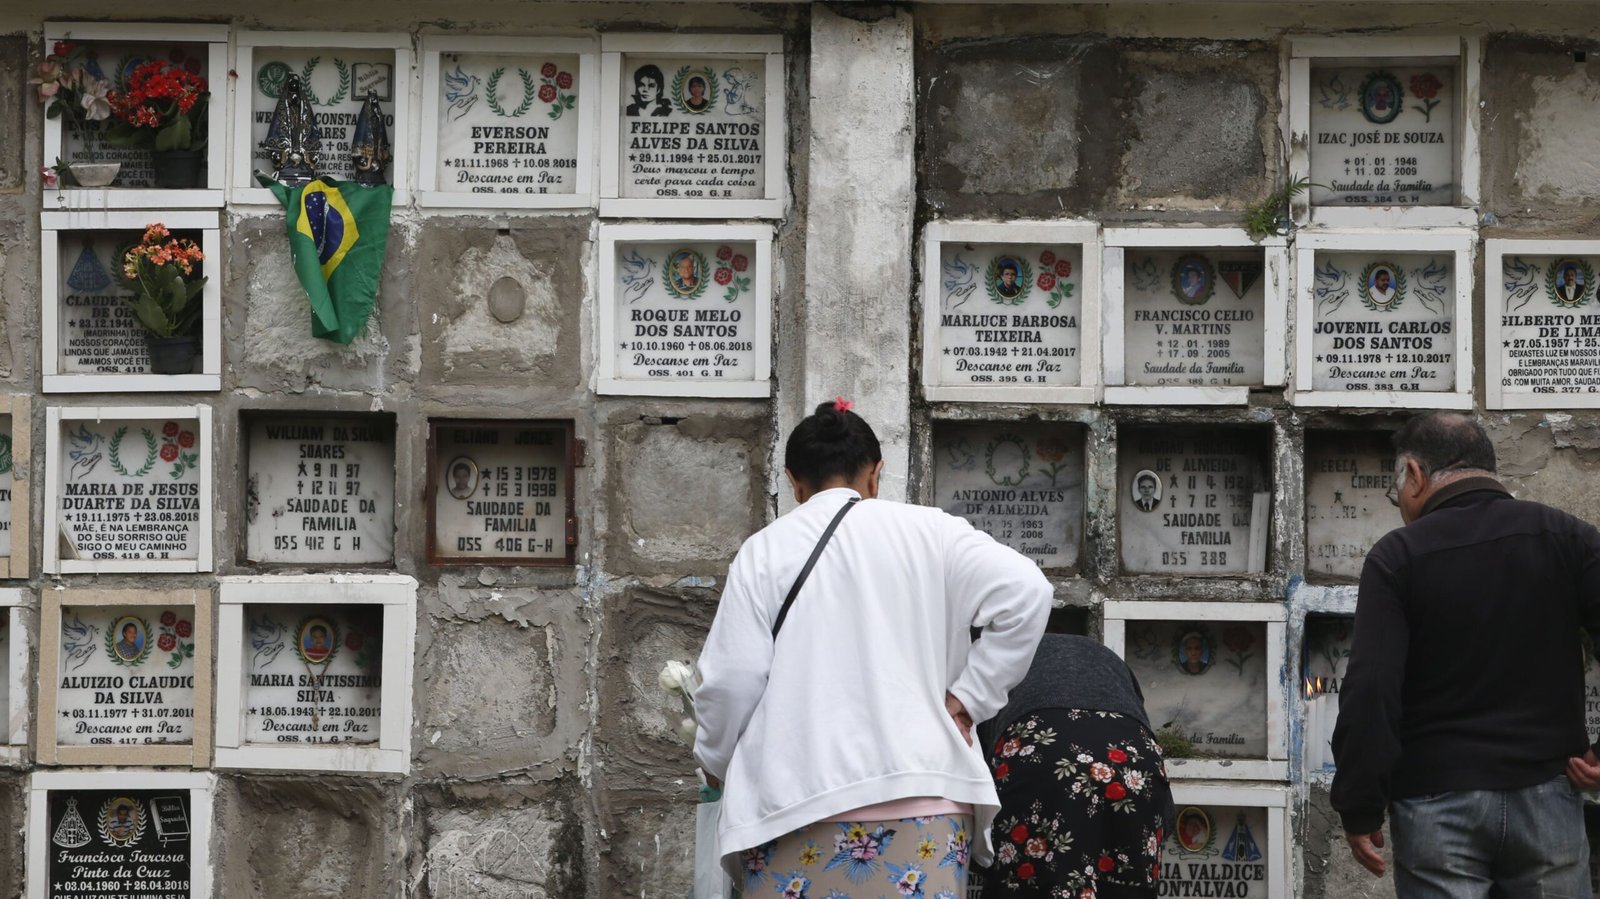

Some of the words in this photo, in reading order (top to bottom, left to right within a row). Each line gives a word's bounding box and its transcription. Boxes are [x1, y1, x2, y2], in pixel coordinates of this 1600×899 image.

[471, 126, 550, 139] EVERSON
[631, 122, 690, 134] FELIPE
[696, 122, 760, 136] SANTOS
[630, 137, 681, 149] ALVES
[687, 138, 708, 150] DA
[714, 138, 759, 151] SILVA
[1318, 133, 1347, 144] IZAC
[1350, 130, 1381, 147] JOSÉ
[1384, 133, 1400, 144] DE
[1404, 133, 1445, 144] SOUZA
[473, 142, 547, 154] PEREIRA
[454, 159, 509, 168] 21.11.1968
[639, 154, 694, 163] 29.11.1994
[708, 154, 762, 164] 25.01.2017
[632, 164, 661, 174] Deus
[665, 166, 708, 174] marcou
[721, 166, 755, 177] tempo
[457, 170, 513, 184] Descanse
[517, 175, 534, 184] em
[538, 171, 563, 184] Paz
[634, 177, 661, 185] certo
[664, 178, 693, 188] para
[696, 177, 724, 186] cada
[727, 178, 756, 187] coisa
[1331, 180, 1374, 193] Saudade
[1377, 180, 1390, 191] da
[1393, 180, 1433, 192] Familia
[92, 308, 110, 318] DE
[631, 309, 689, 322] ROQUE
[695, 309, 742, 322] MELO
[1134, 310, 1211, 322] FRANCISCO
[1214, 310, 1255, 322] CELIO
[79, 320, 134, 328] 23.12.1944
[941, 315, 1008, 327] MARLUCE
[1012, 316, 1077, 328] BARBOSA
[635, 324, 668, 337] DOS
[673, 325, 738, 338] SANTOS
[1172, 324, 1232, 335] MARTINS
[1314, 322, 1383, 334] JOVENIL
[1388, 322, 1451, 334] CARLOS
[1539, 327, 1560, 338] DE
[975, 330, 1042, 343] TEIXEIRA
[69, 339, 101, 347] NOSSOS
[102, 337, 145, 349] CORAÇÕES
[631, 342, 685, 351] 10.10.1960
[698, 342, 753, 351] 08.06.2018
[1333, 337, 1365, 349] DOS
[1370, 337, 1433, 349] SANTOS
[1513, 339, 1570, 348] 27.05.1957
[64, 348, 92, 356] LINDAS
[94, 348, 109, 356] QUE
[111, 348, 139, 356] JAMAIS
[953, 347, 1008, 357] 07.03.1942
[1022, 347, 1076, 357] 21.04.2017
[1509, 350, 1544, 358] DEIXASTES
[1545, 350, 1558, 358] LUZ
[1559, 350, 1569, 358] EM
[1570, 350, 1597, 358] NOSSOS
[113, 356, 134, 365] VOCÊ
[633, 353, 689, 366] Descanse
[693, 358, 710, 366] em
[713, 354, 738, 367] Paz
[1326, 354, 1382, 363] 09.11.1978
[1396, 354, 1451, 363] 12.10.2017
[1525, 359, 1569, 368] LEMBRANÇAS
[956, 359, 1012, 372] Descanse
[1016, 364, 1033, 372] em
[1036, 360, 1062, 372] Paz
[1144, 362, 1187, 374] Saudade
[1190, 362, 1203, 374] da
[1206, 362, 1245, 374] Familia
[1329, 366, 1386, 379] Descanse
[1390, 370, 1407, 379] em
[1411, 366, 1437, 379] Paz
[1531, 378, 1550, 386] MUITA
[300, 444, 345, 459] SOARES
[1183, 458, 1238, 473] ALMEIDA
[65, 483, 117, 496] MARIA
[122, 483, 144, 496] DE
[149, 483, 198, 496] JESUS
[953, 490, 1016, 502] ANTONIO
[1020, 491, 1064, 502] ALVES
[63, 498, 125, 510] DUARTE
[130, 498, 151, 510] DA
[157, 498, 200, 510] SILVA
[287, 498, 348, 514] SAUDADE
[359, 499, 376, 514] DA
[467, 501, 524, 516] SAUDADE
[536, 502, 551, 516] DA
[988, 504, 1049, 516] ALMEIDA
[76, 513, 130, 522] 19.11.1975
[144, 513, 199, 522] 23.08.2018
[1163, 513, 1221, 527] SAUDADE
[110, 524, 123, 532] NA
[126, 524, 189, 533] LEMBRANÇA
[302, 517, 357, 531] FAMILIA
[485, 518, 537, 532] FAMILIA
[1181, 531, 1231, 545] FAMILIA
[78, 543, 102, 551] SIGO
[115, 543, 137, 551] MEU
[140, 543, 187, 551] CAMINHO
[61, 676, 124, 689] ALUIZIO
[251, 674, 294, 687] MARIA
[94, 692, 116, 704] DA
[120, 692, 164, 704] SILVA
[297, 690, 335, 703] SILVA
[72, 708, 127, 718] 03.11.1977
[260, 707, 314, 717] 18.05.1943
[75, 721, 132, 734] Descanse
[136, 726, 153, 734] em
[157, 721, 182, 734] Paz
[322, 724, 339, 732] em
[343, 720, 369, 733] Paz
[57, 850, 125, 864] Francisco
[71, 865, 110, 879] Pinto
[113, 865, 133, 879] da
[136, 865, 172, 879] Cruz
[1188, 863, 1264, 881] VALDICE
[64, 881, 120, 891] 03.04.1960
[134, 880, 189, 891] 26.04.2018
[1158, 880, 1249, 898] ONTALVAO
